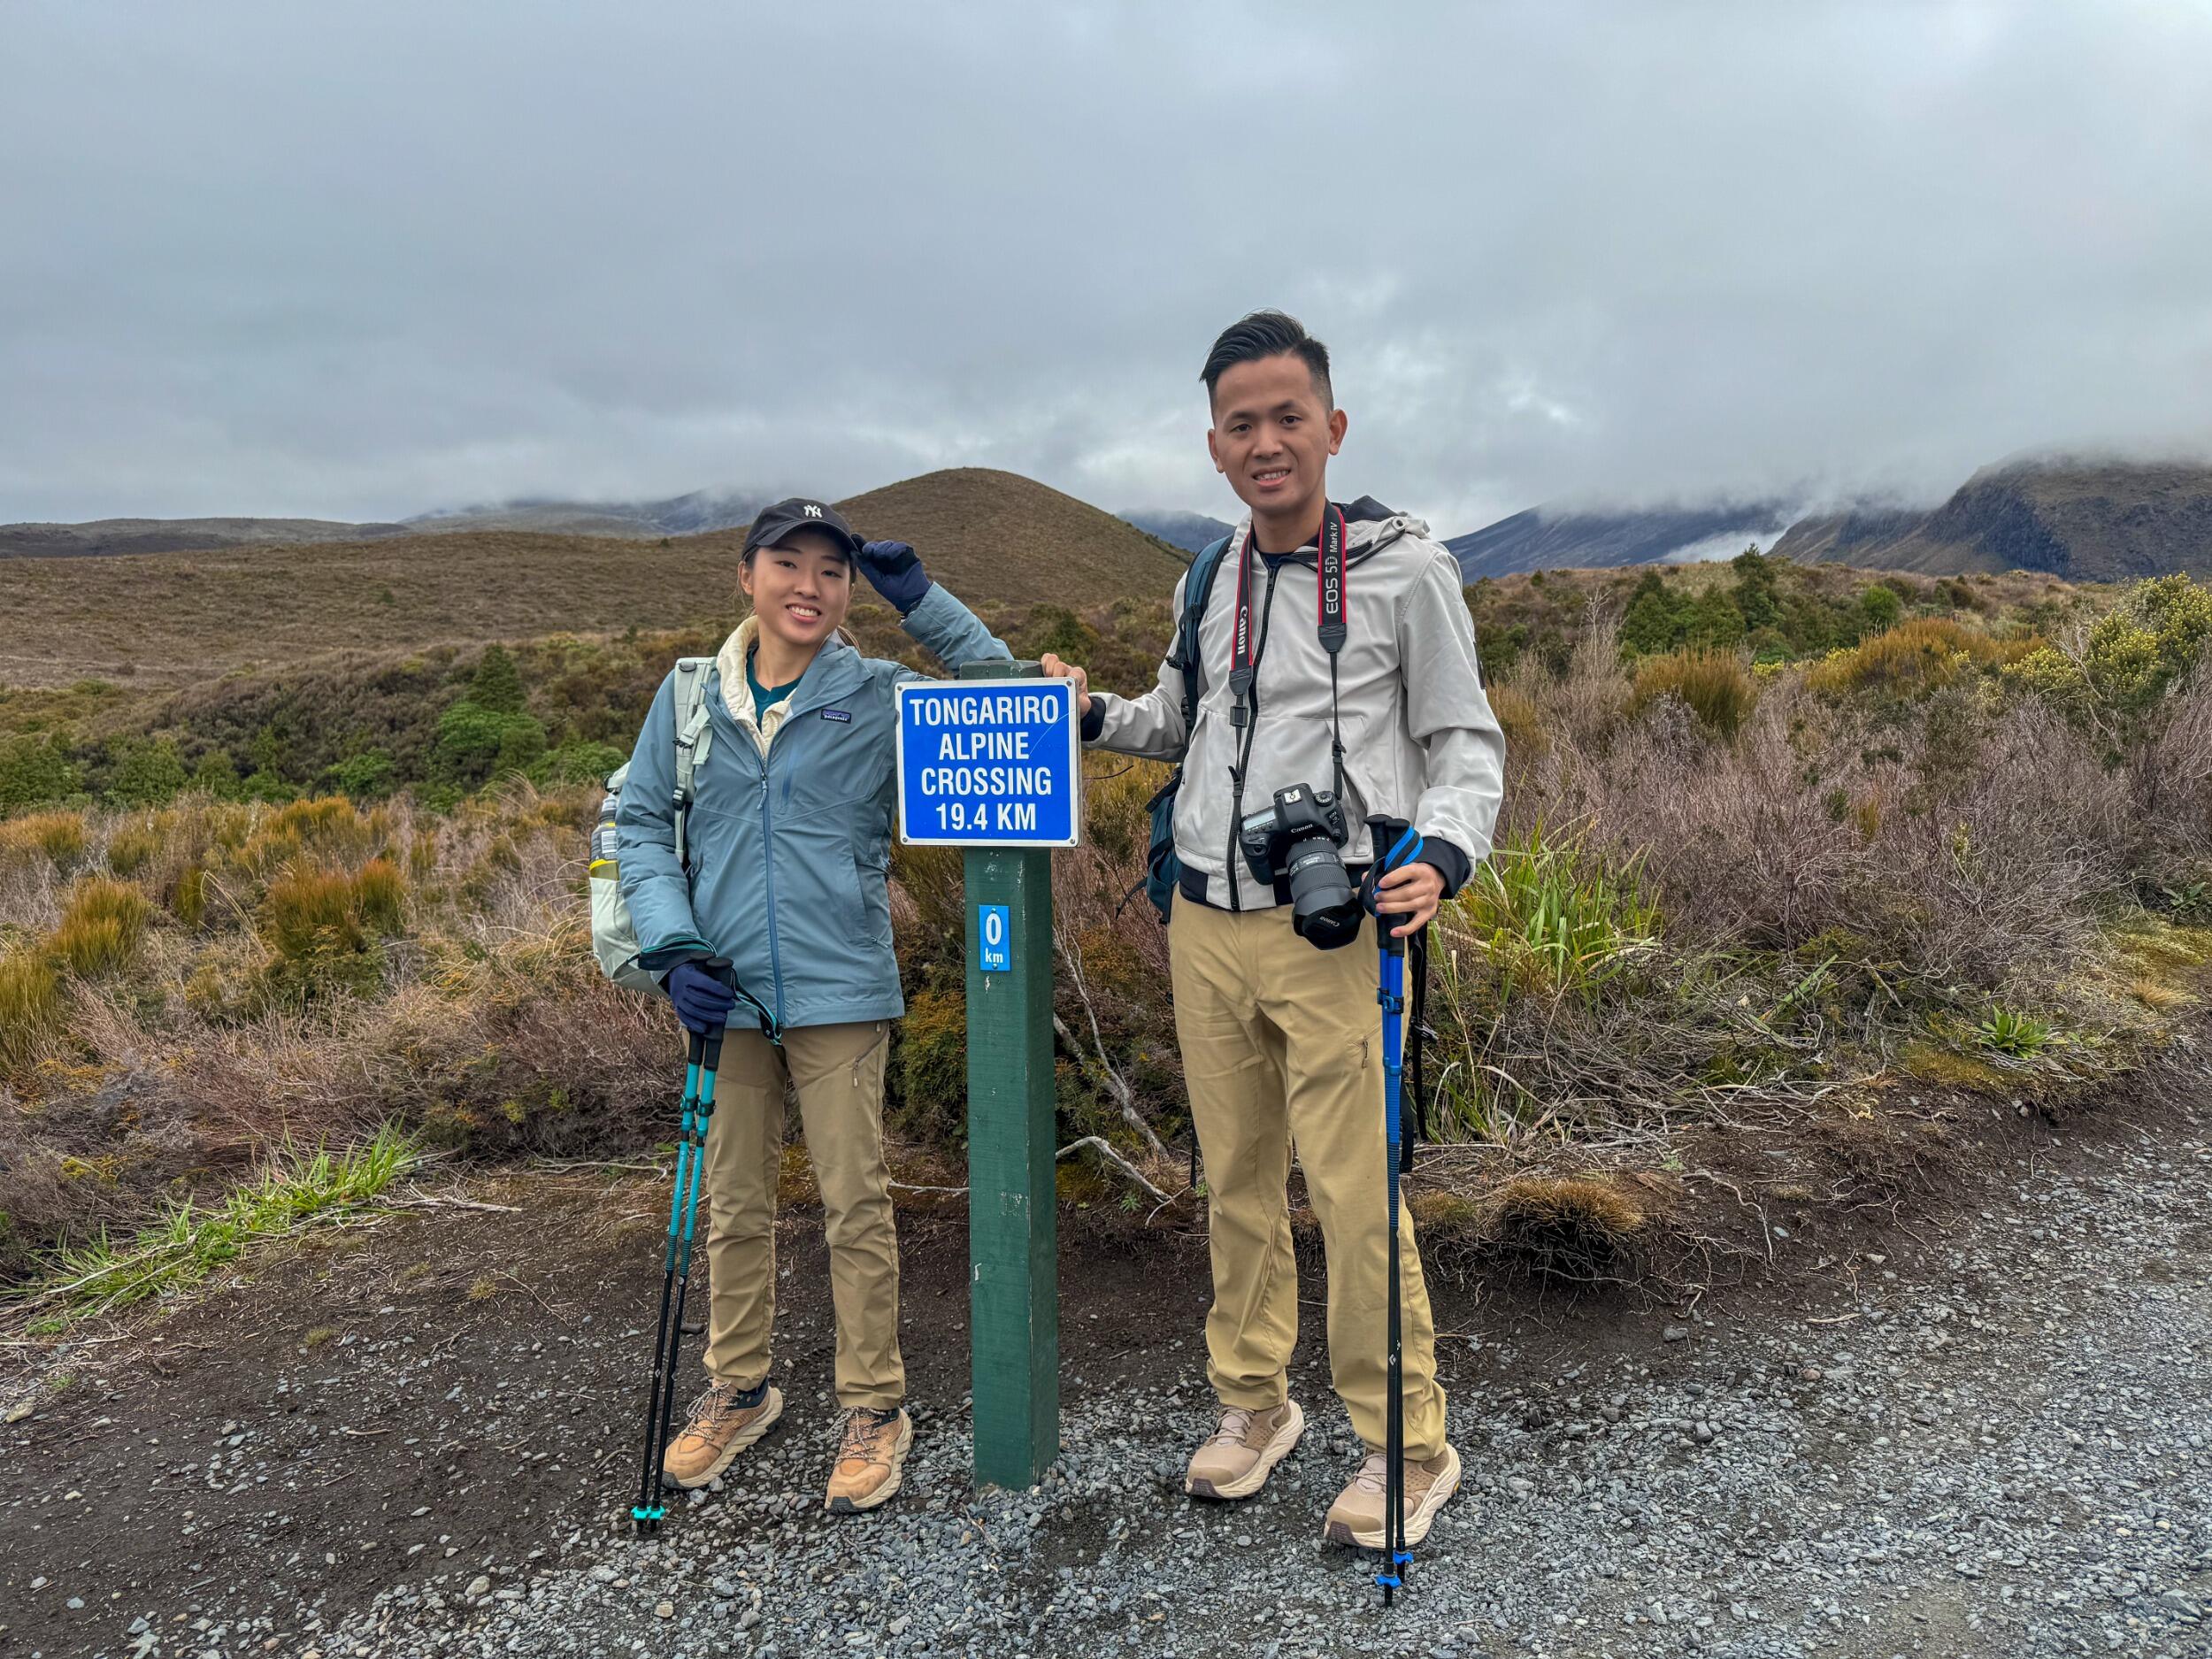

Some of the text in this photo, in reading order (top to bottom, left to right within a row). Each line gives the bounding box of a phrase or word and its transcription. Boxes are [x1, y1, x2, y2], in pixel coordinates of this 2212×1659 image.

[1329, 532, 1338, 553] Mark
[1325, 556, 1338, 573] 5D
[1325, 578, 1339, 614] EOS
[1237, 605, 1248, 655] Canon
[909, 695, 1059, 726] TONGARIRO
[939, 732, 1030, 760] ALPINE
[921, 767, 1052, 795] CROSSING
[935, 803, 1036, 831] 19.4 KM
[1290, 823, 1313, 833] Canon
[986, 912, 1002, 946] 0
[985, 947, 1003, 964] km
